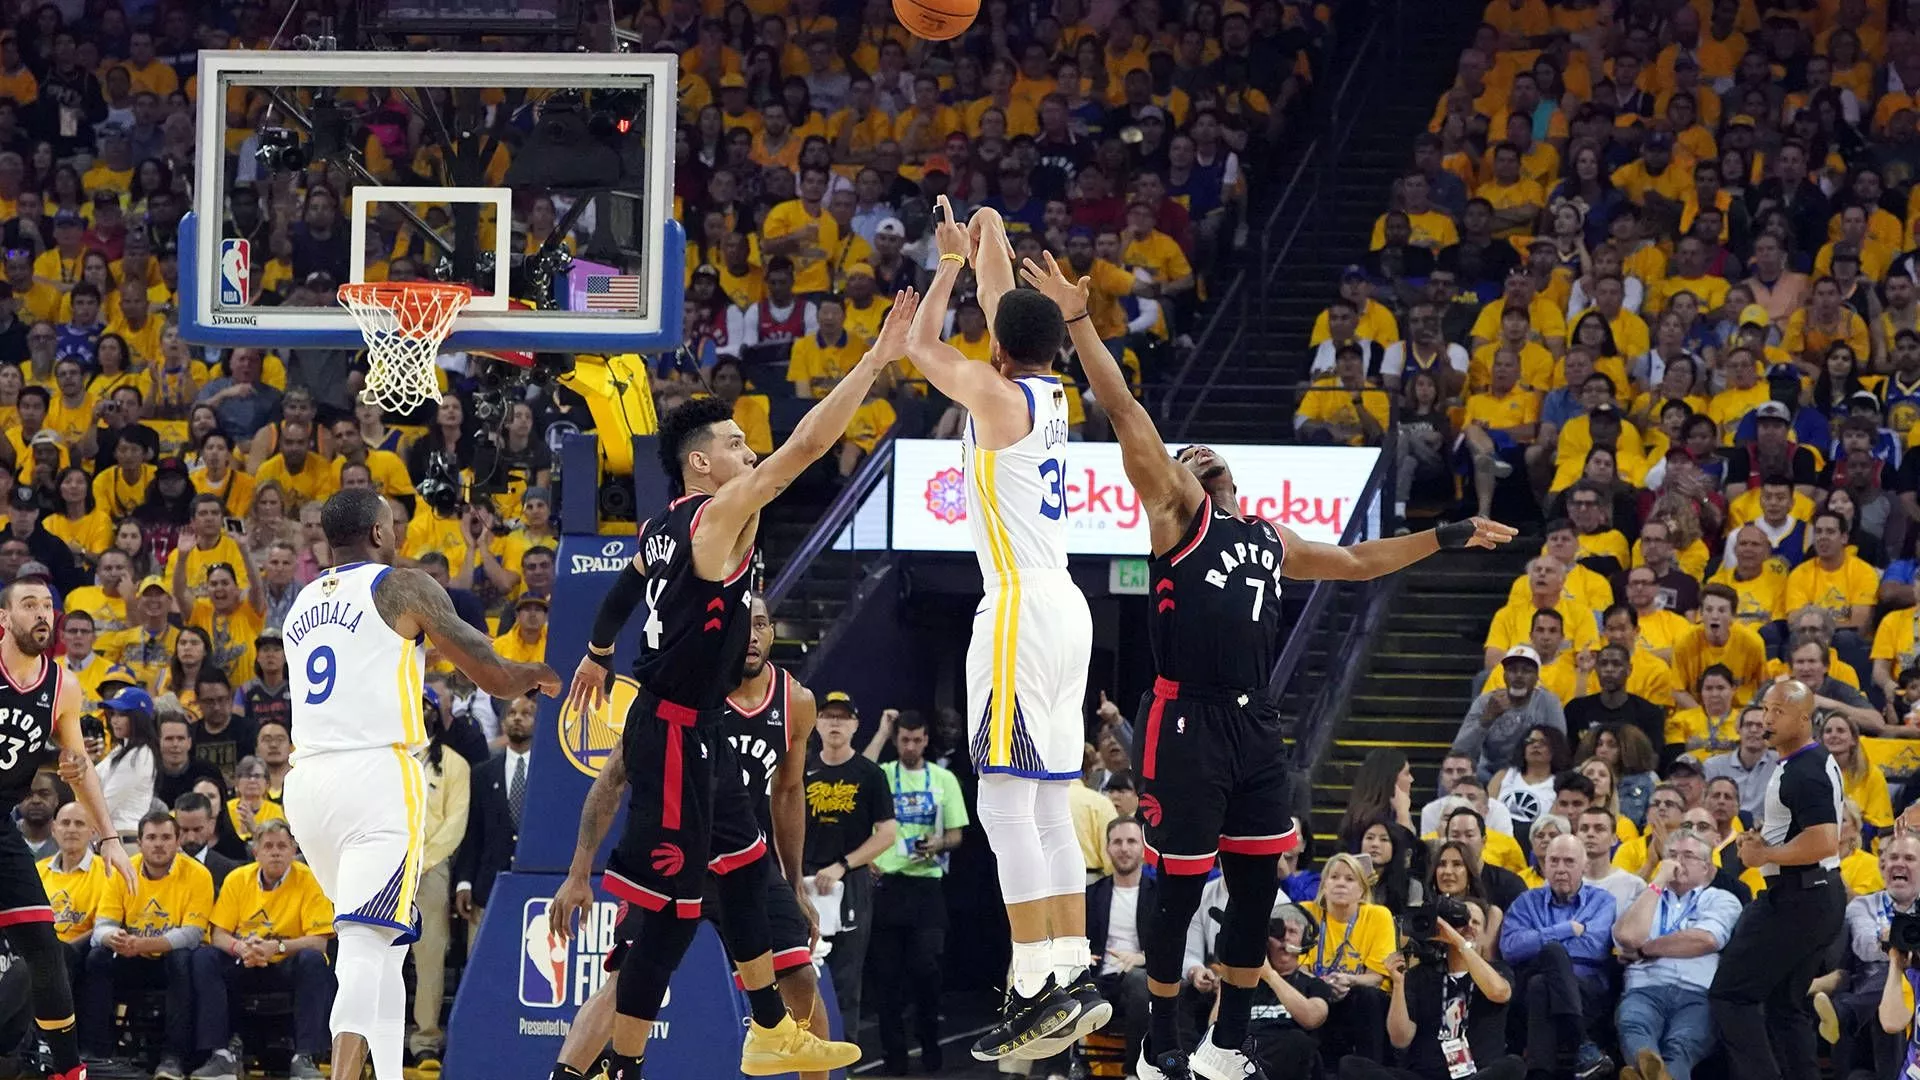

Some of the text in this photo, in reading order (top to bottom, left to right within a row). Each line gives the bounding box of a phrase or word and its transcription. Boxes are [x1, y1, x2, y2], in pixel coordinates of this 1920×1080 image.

[223, 290, 238, 303] NBA
[212, 315, 257, 326] SPALDING
[1065, 468, 1141, 529] cky
[1239, 480, 1341, 529] ucky
[645, 535, 677, 567] GREEN
[1119, 560, 1145, 588] EXI
[643, 577, 668, 650] 4
[1246, 577, 1265, 622] 7
[286, 600, 364, 647] IGUODALA
[304, 645, 336, 705] 9
[577, 901, 619, 953] NB
[519, 1017, 670, 1039] Presented by TV
